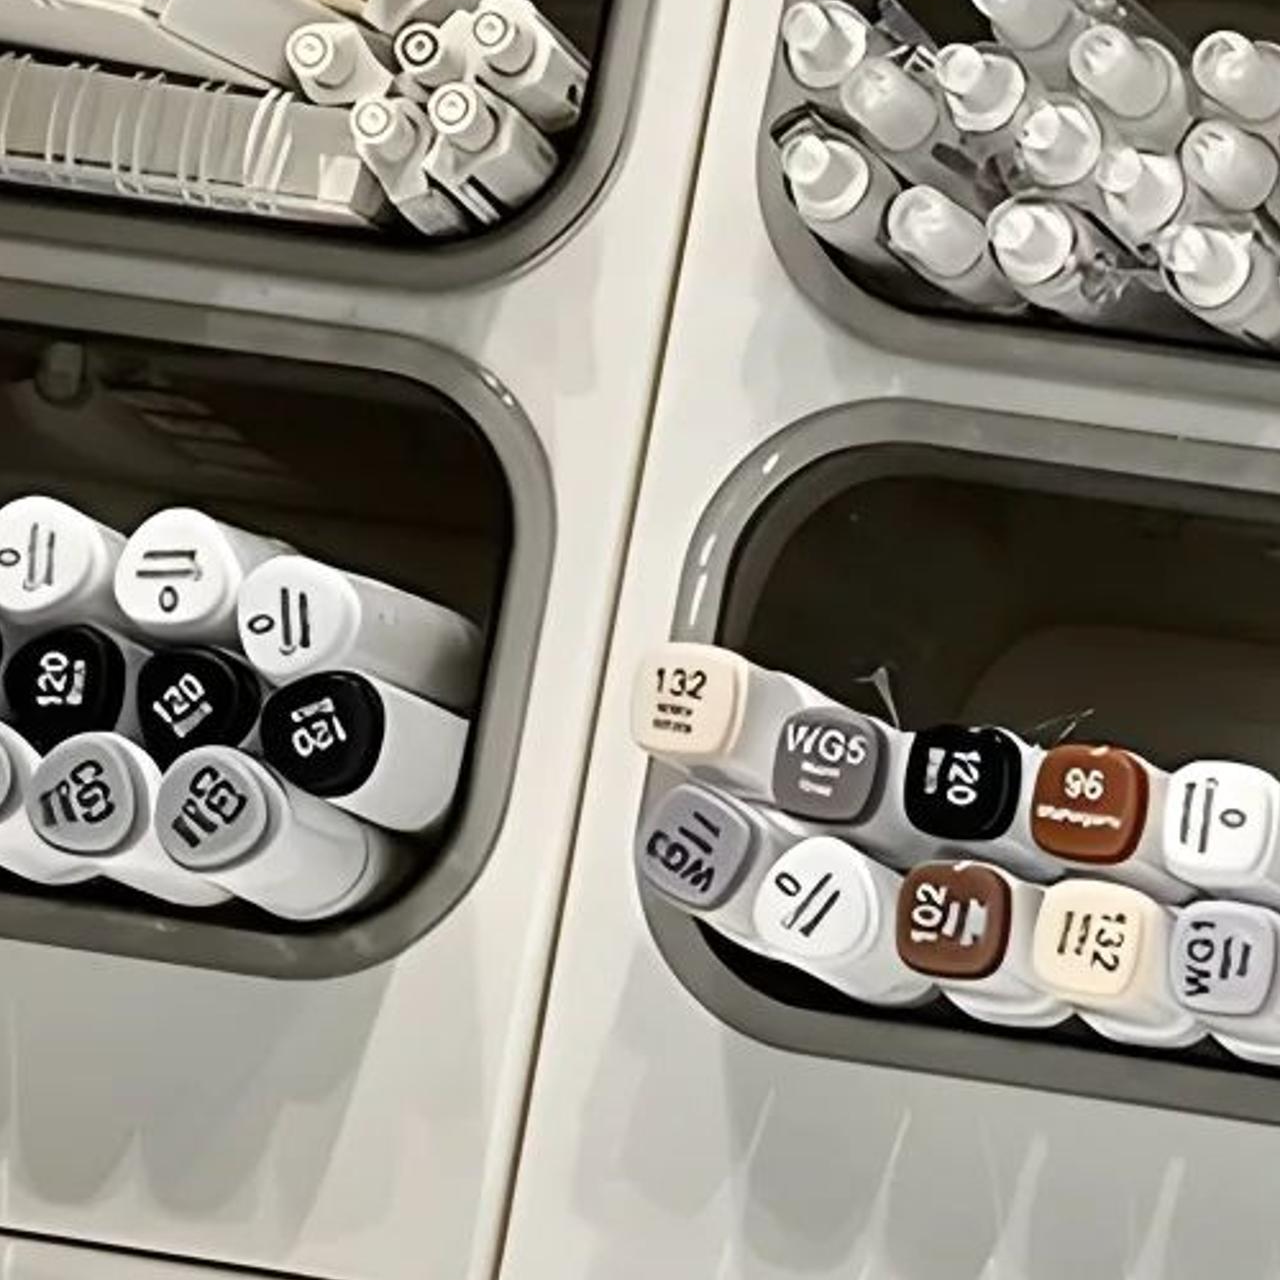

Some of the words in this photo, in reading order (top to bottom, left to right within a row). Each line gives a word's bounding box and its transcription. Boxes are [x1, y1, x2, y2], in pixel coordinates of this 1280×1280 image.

[656, 667, 708, 701] 132
[945, 750, 983, 807] 120
[1063, 767, 1105, 801] 96
[910, 882, 947, 944] 102
[1089, 911, 1126, 974] 132
